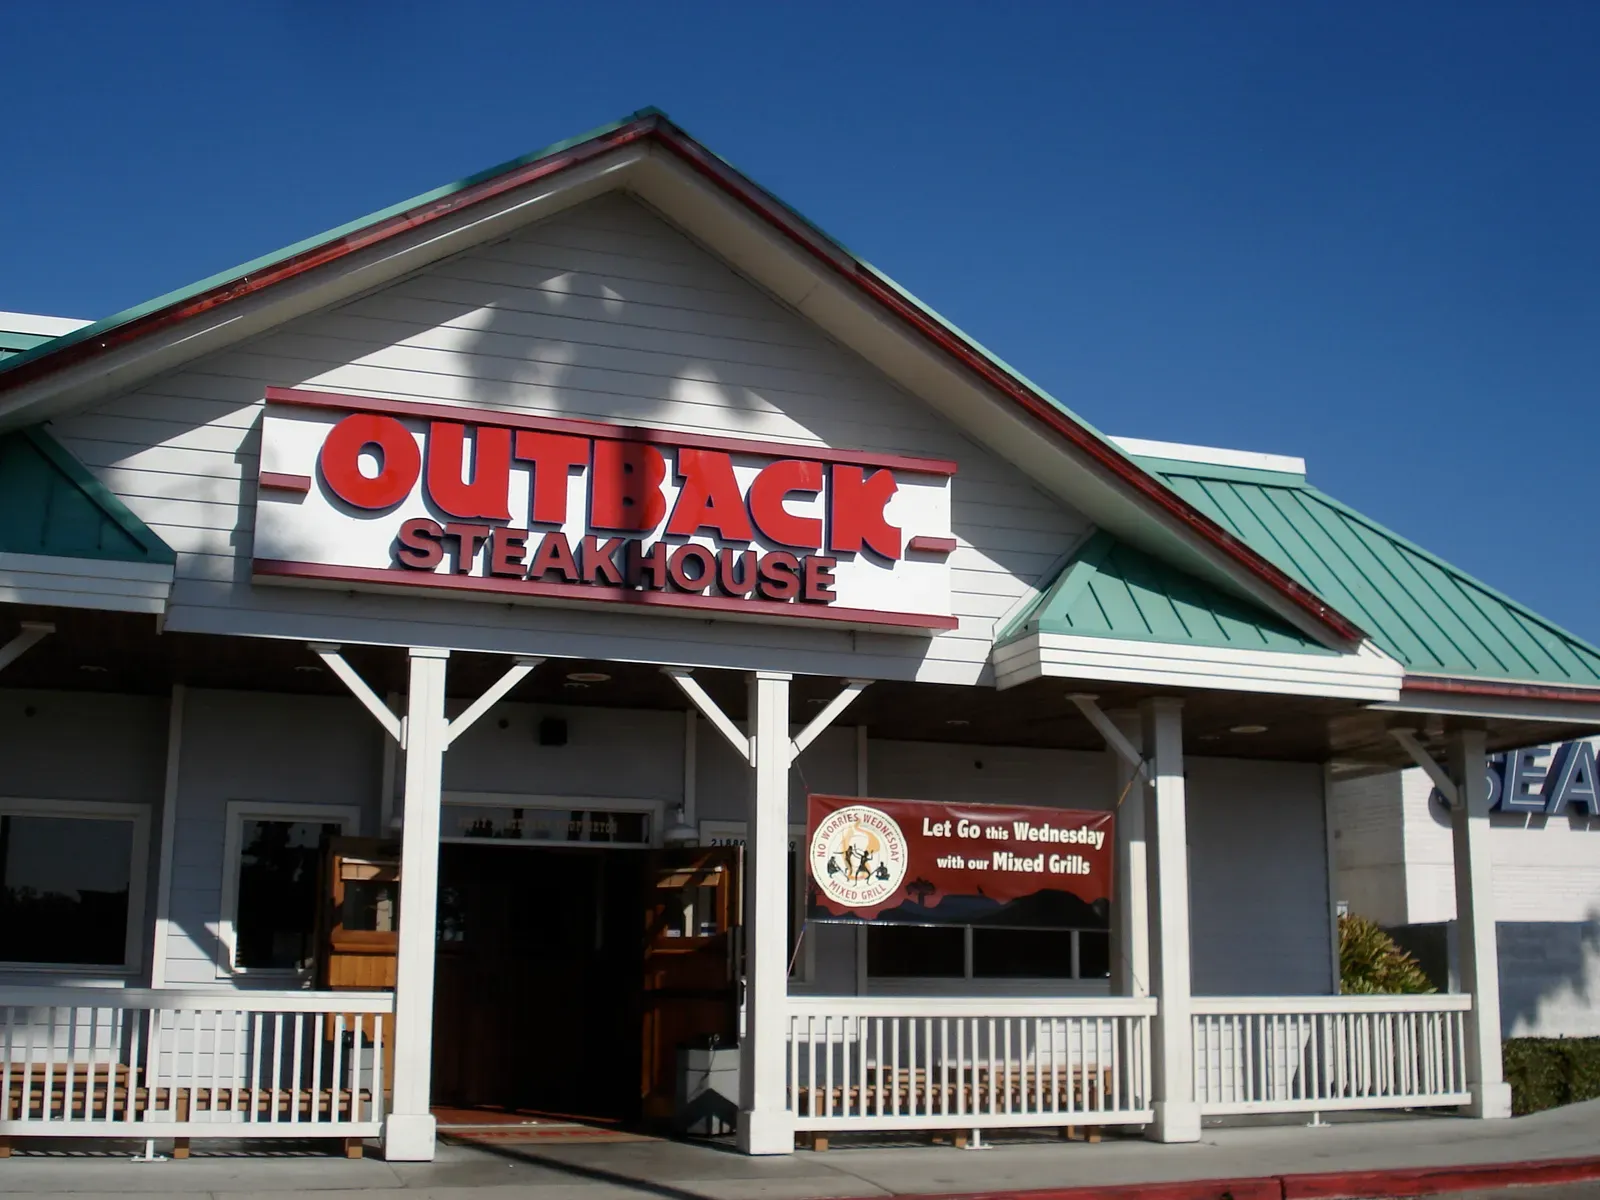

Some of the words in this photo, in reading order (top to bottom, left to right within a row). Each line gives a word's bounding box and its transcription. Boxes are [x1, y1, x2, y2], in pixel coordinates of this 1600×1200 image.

[321, 412, 902, 561] OUTBACK
[396, 517, 837, 604] STEAKHOUSE
[821, 813, 860, 840] WORRIES
[863, 813, 900, 863] WEDNESDAY
[922, 817, 951, 837] Let
[957, 819, 981, 839] Go
[985, 826, 1009, 841] this
[1013, 821, 1105, 850] Wednesday
[817, 843, 826, 858] NO
[937, 855, 965, 869] with
[968, 858, 989, 870] our
[993, 851, 1044, 873] Mixed
[1049, 854, 1091, 875] Grills
[829, 880, 858, 900] MIXED
[861, 883, 887, 900] GRILL
